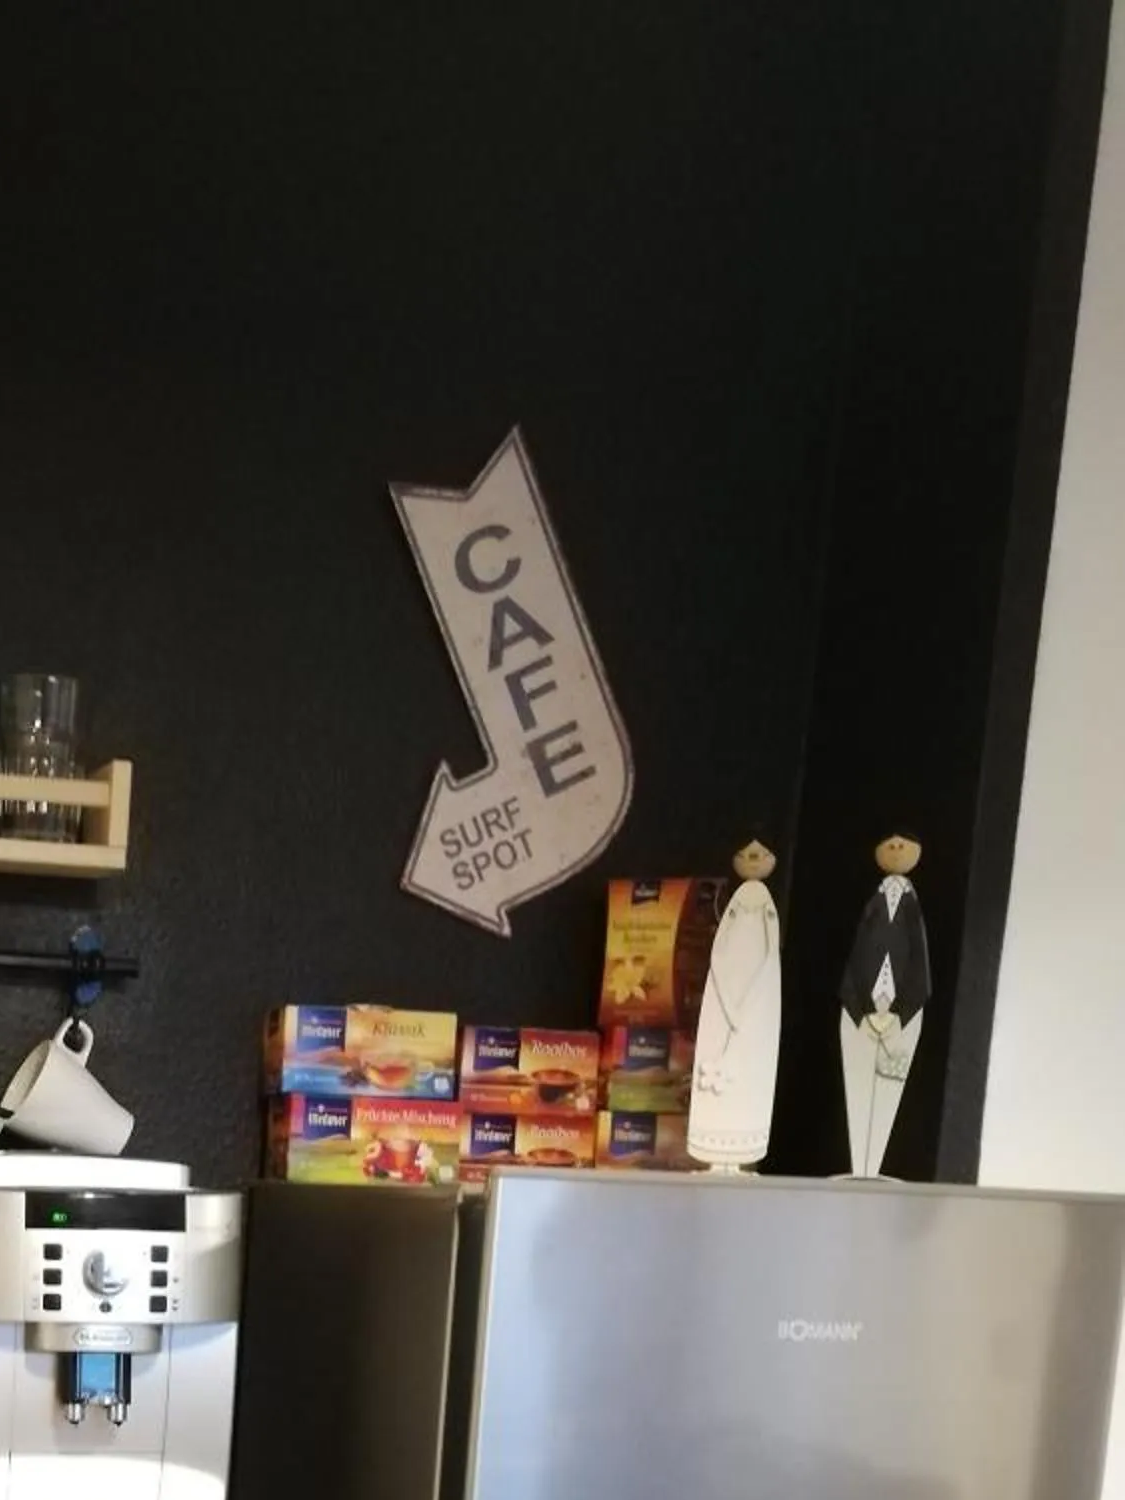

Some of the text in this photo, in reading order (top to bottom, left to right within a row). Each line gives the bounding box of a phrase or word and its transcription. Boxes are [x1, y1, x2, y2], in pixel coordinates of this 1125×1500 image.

[453, 523, 597, 799] CAFE
[438, 796, 523, 861] SURF
[451, 828, 536, 892] SPOT
